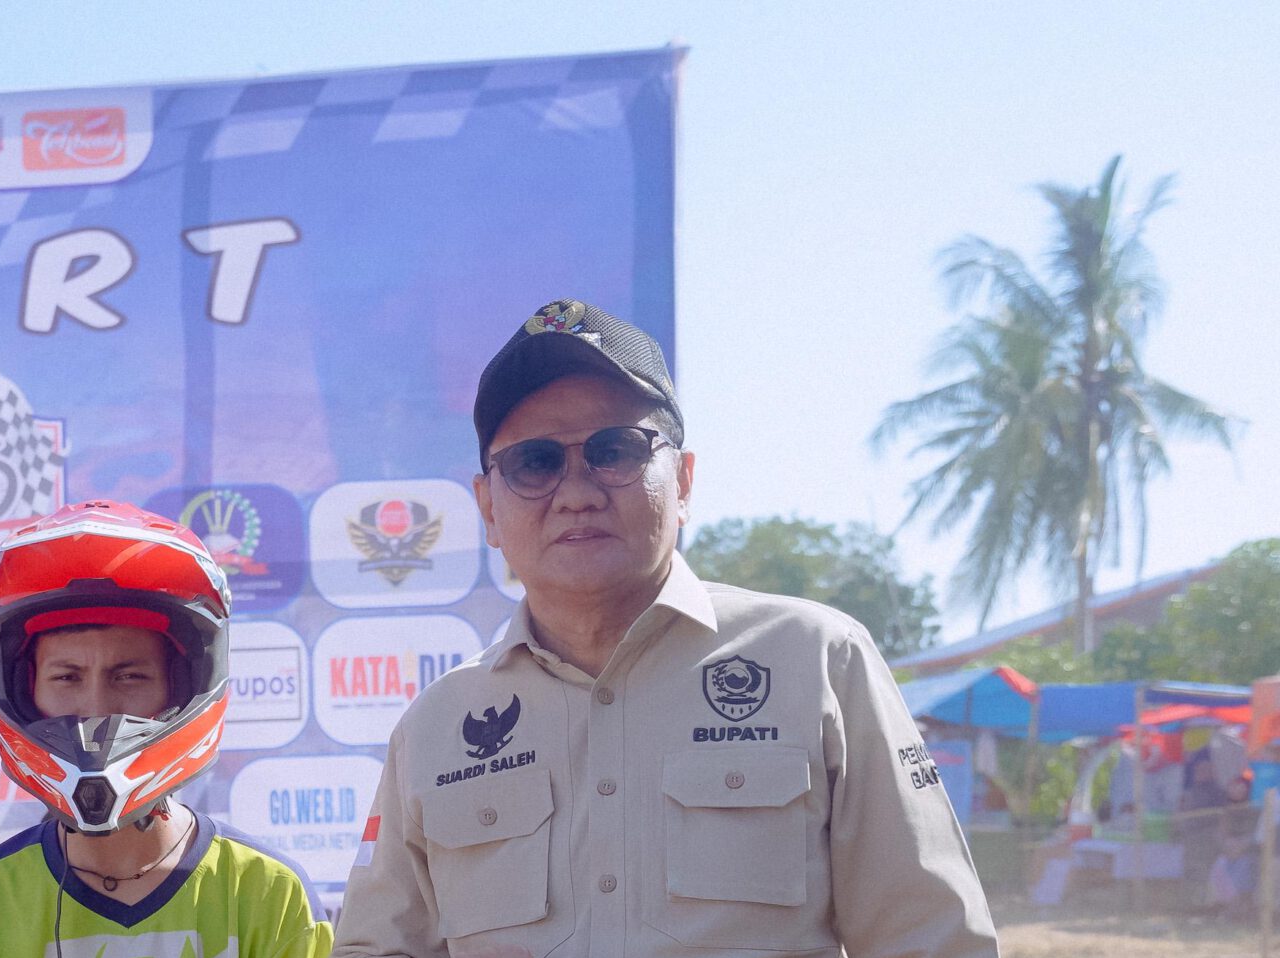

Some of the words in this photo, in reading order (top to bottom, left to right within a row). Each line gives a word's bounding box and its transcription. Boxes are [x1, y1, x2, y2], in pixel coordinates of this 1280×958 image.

[692, 727, 779, 742] BUPATI
[435, 764, 486, 787] SUARDI
[489, 751, 536, 774] SALEH
